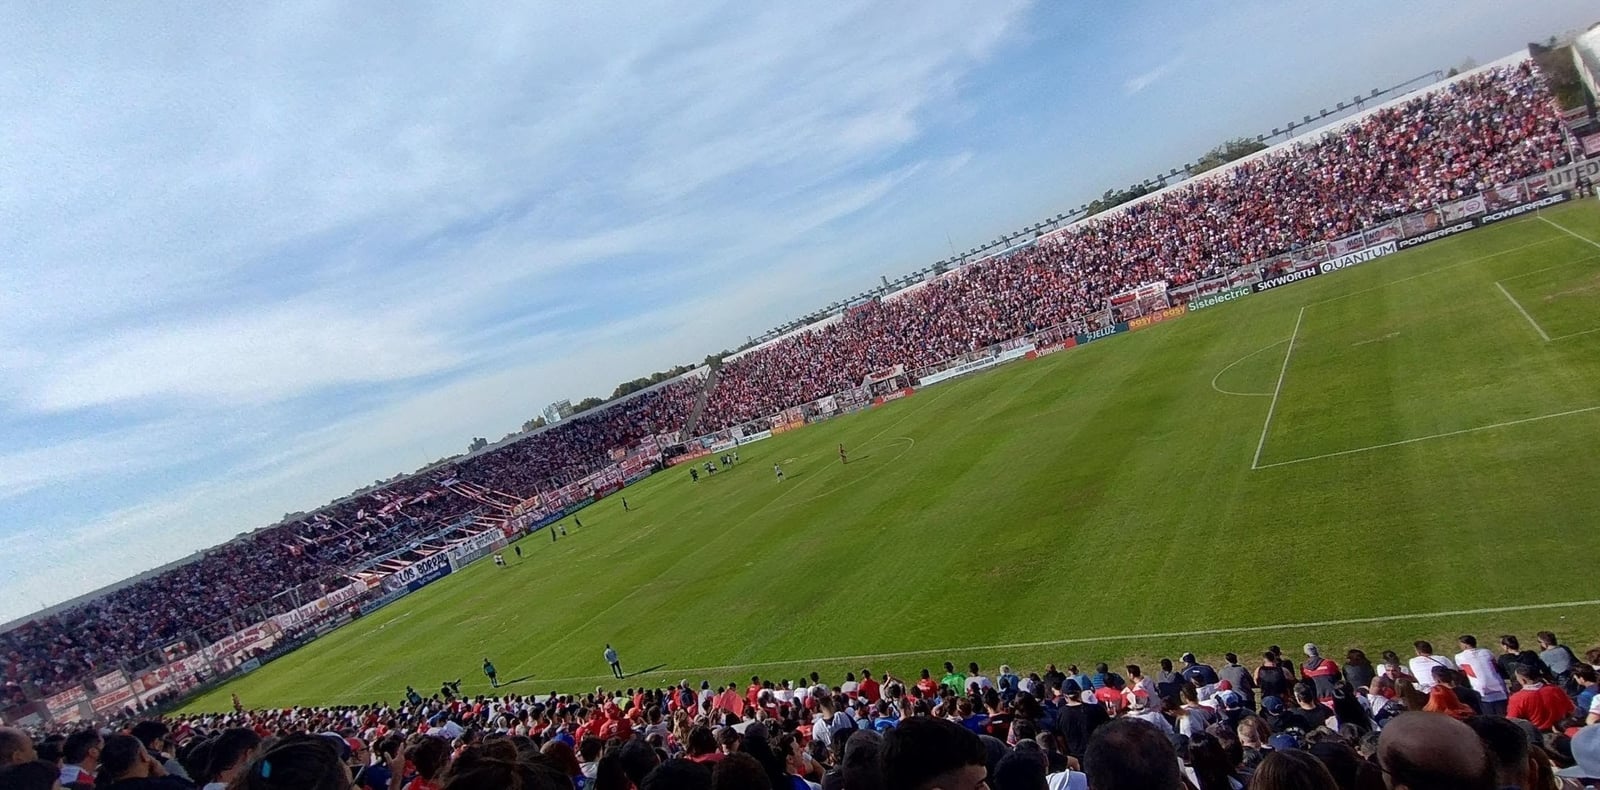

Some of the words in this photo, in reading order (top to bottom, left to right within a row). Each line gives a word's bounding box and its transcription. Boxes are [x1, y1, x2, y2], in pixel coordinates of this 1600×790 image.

[1481, 193, 1564, 224] POWERADE
[1399, 220, 1473, 248] POWERADE
[1321, 243, 1396, 273] QUANTUM
[1257, 267, 1316, 291] SKYWORTH
[1188, 287, 1250, 311] Sistelectric
[1130, 315, 1152, 328] easy
[1163, 305, 1186, 318] easy
[1093, 325, 1116, 339] JELUZ
[1034, 342, 1066, 358] Schneider
[399, 567, 415, 583] LOS
